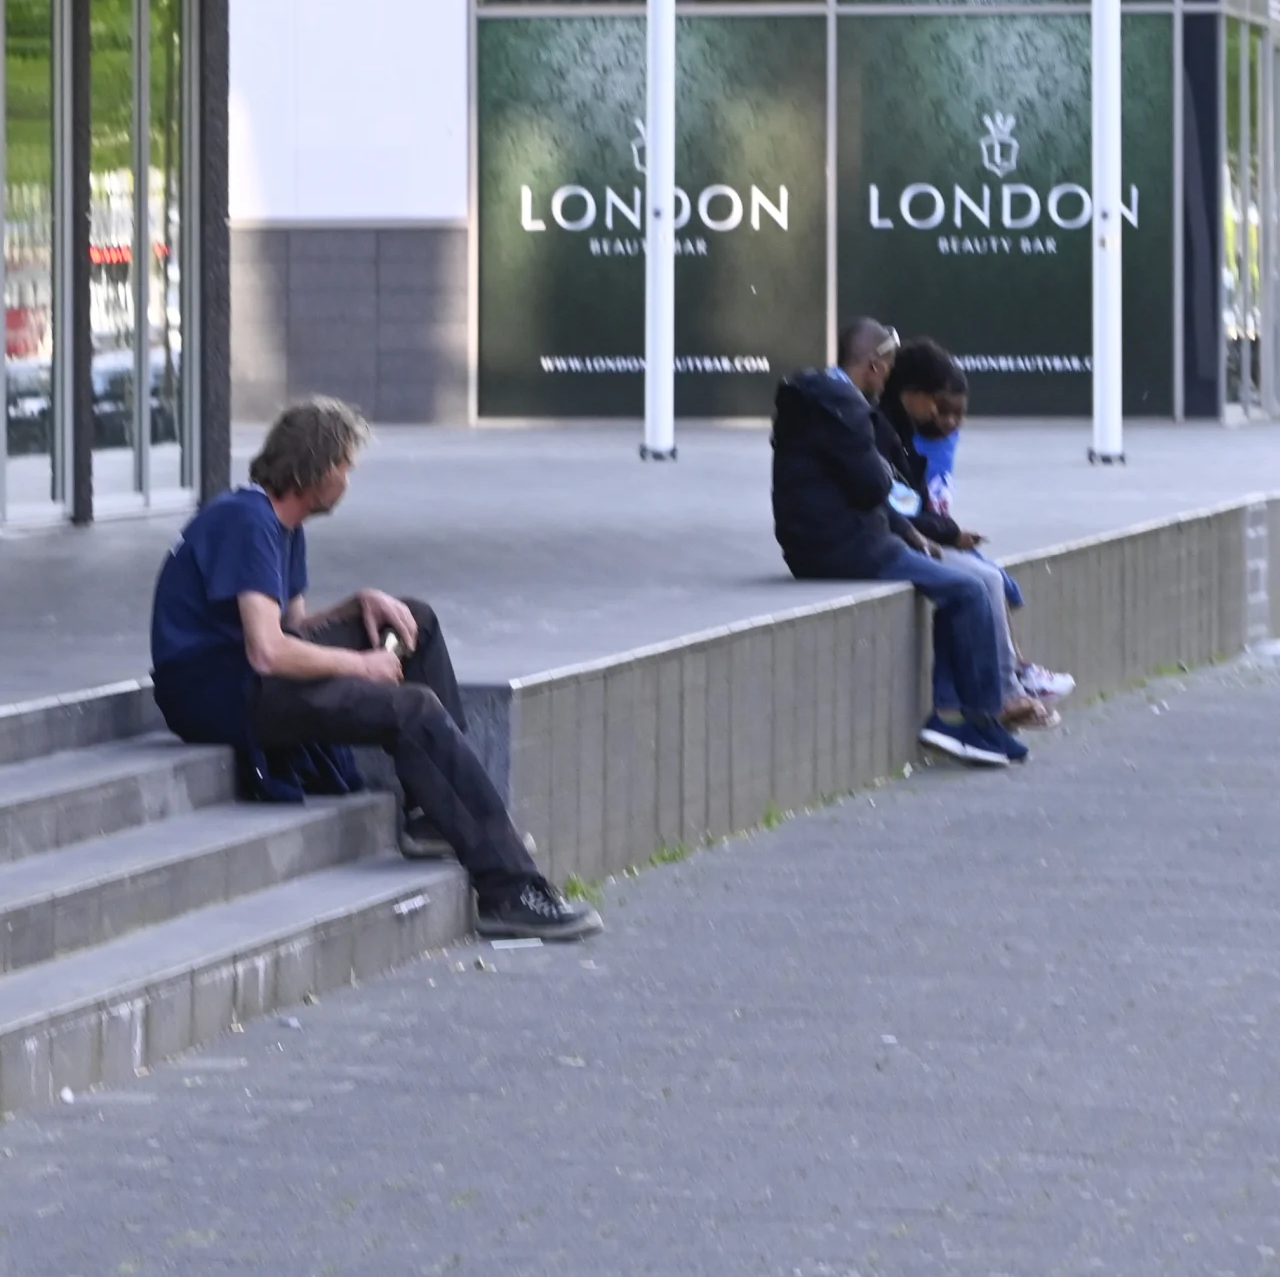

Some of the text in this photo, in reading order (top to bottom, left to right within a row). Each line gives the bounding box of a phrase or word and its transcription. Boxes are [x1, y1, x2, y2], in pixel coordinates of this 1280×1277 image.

[589, 236, 646, 257] BEAU
[938, 235, 1058, 255] BEAUTY BAR
